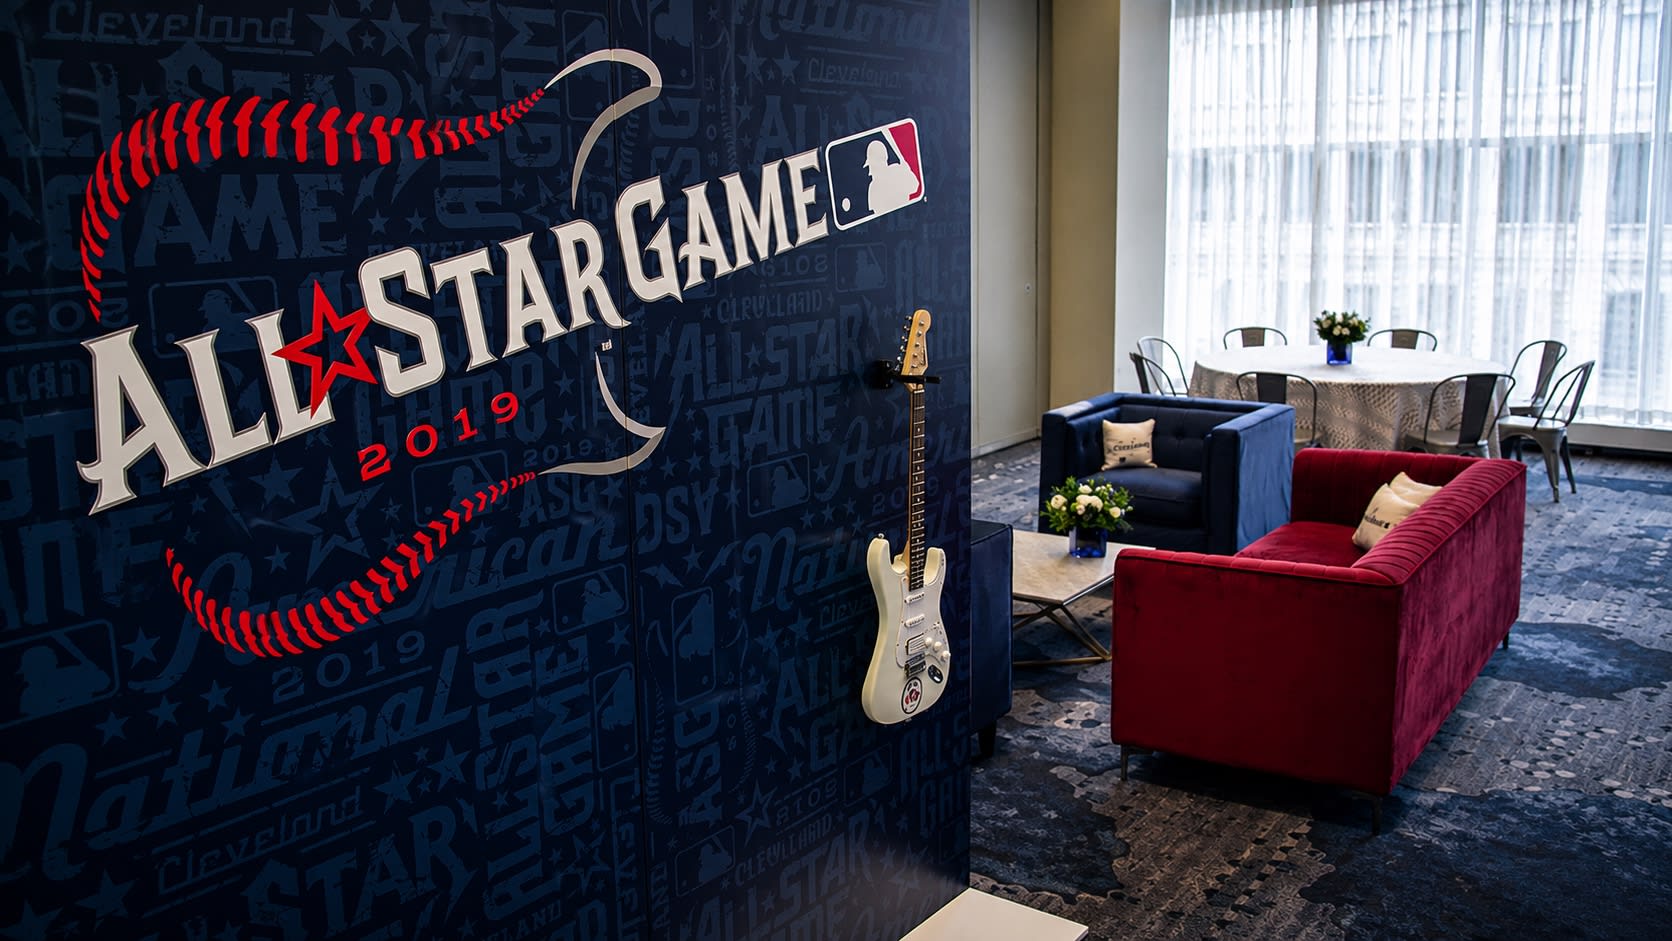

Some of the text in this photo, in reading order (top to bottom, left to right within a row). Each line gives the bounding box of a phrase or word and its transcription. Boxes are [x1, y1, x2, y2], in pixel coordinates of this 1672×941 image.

[47, 0, 296, 46] Cleveland
[77, 307, 337, 515] ALL
[358, 220, 633, 397] STAR
[614, 146, 831, 304] GAME
[356, 389, 520, 482] 2019
[272, 629, 425, 705] 2019
